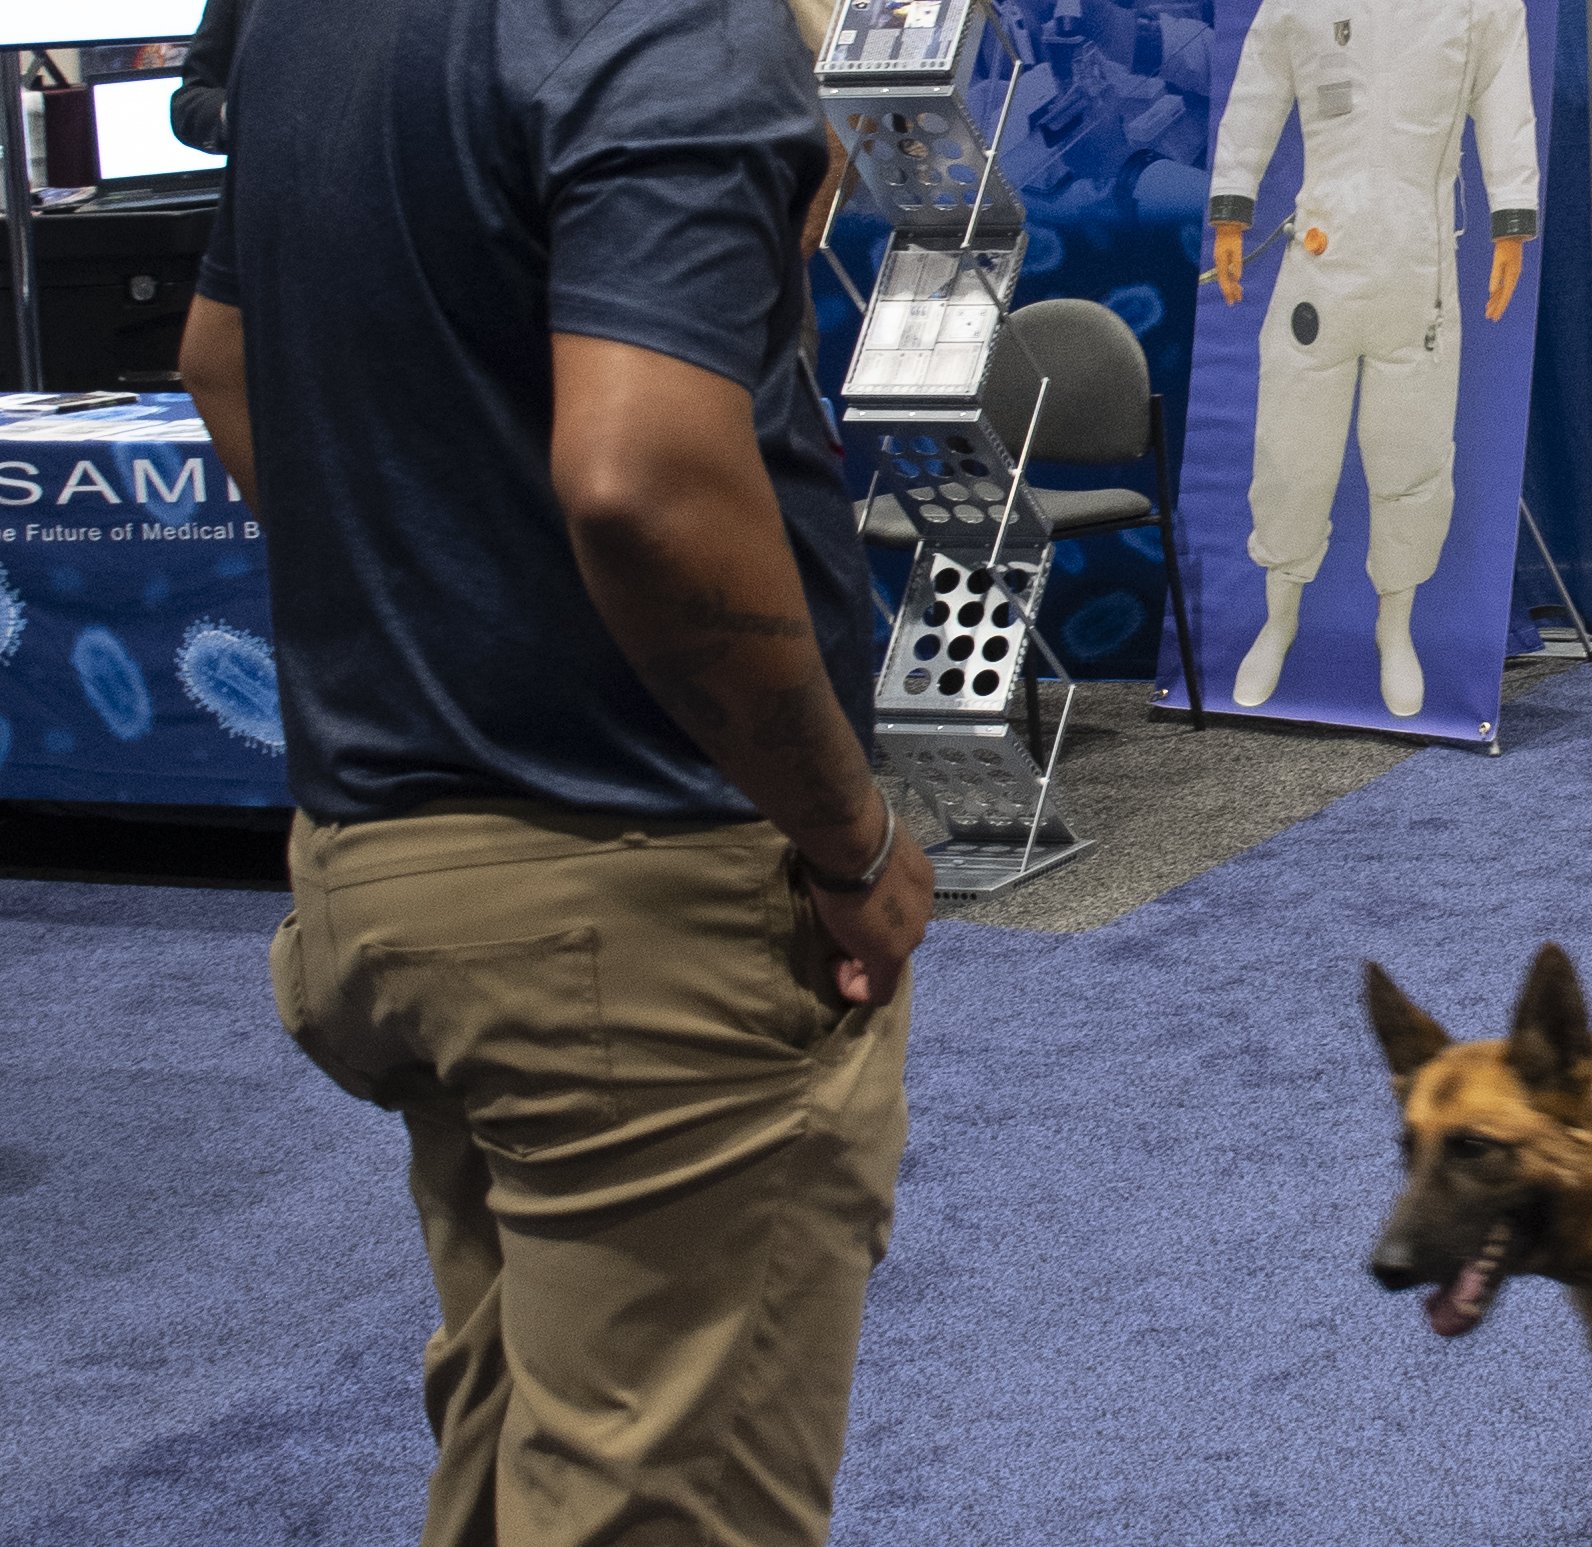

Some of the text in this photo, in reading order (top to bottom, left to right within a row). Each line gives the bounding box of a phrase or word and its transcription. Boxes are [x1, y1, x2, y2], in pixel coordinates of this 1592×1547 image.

[26, 523, 102, 542] Future
[110, 522, 134, 541] of
[142, 521, 235, 541] Medical
